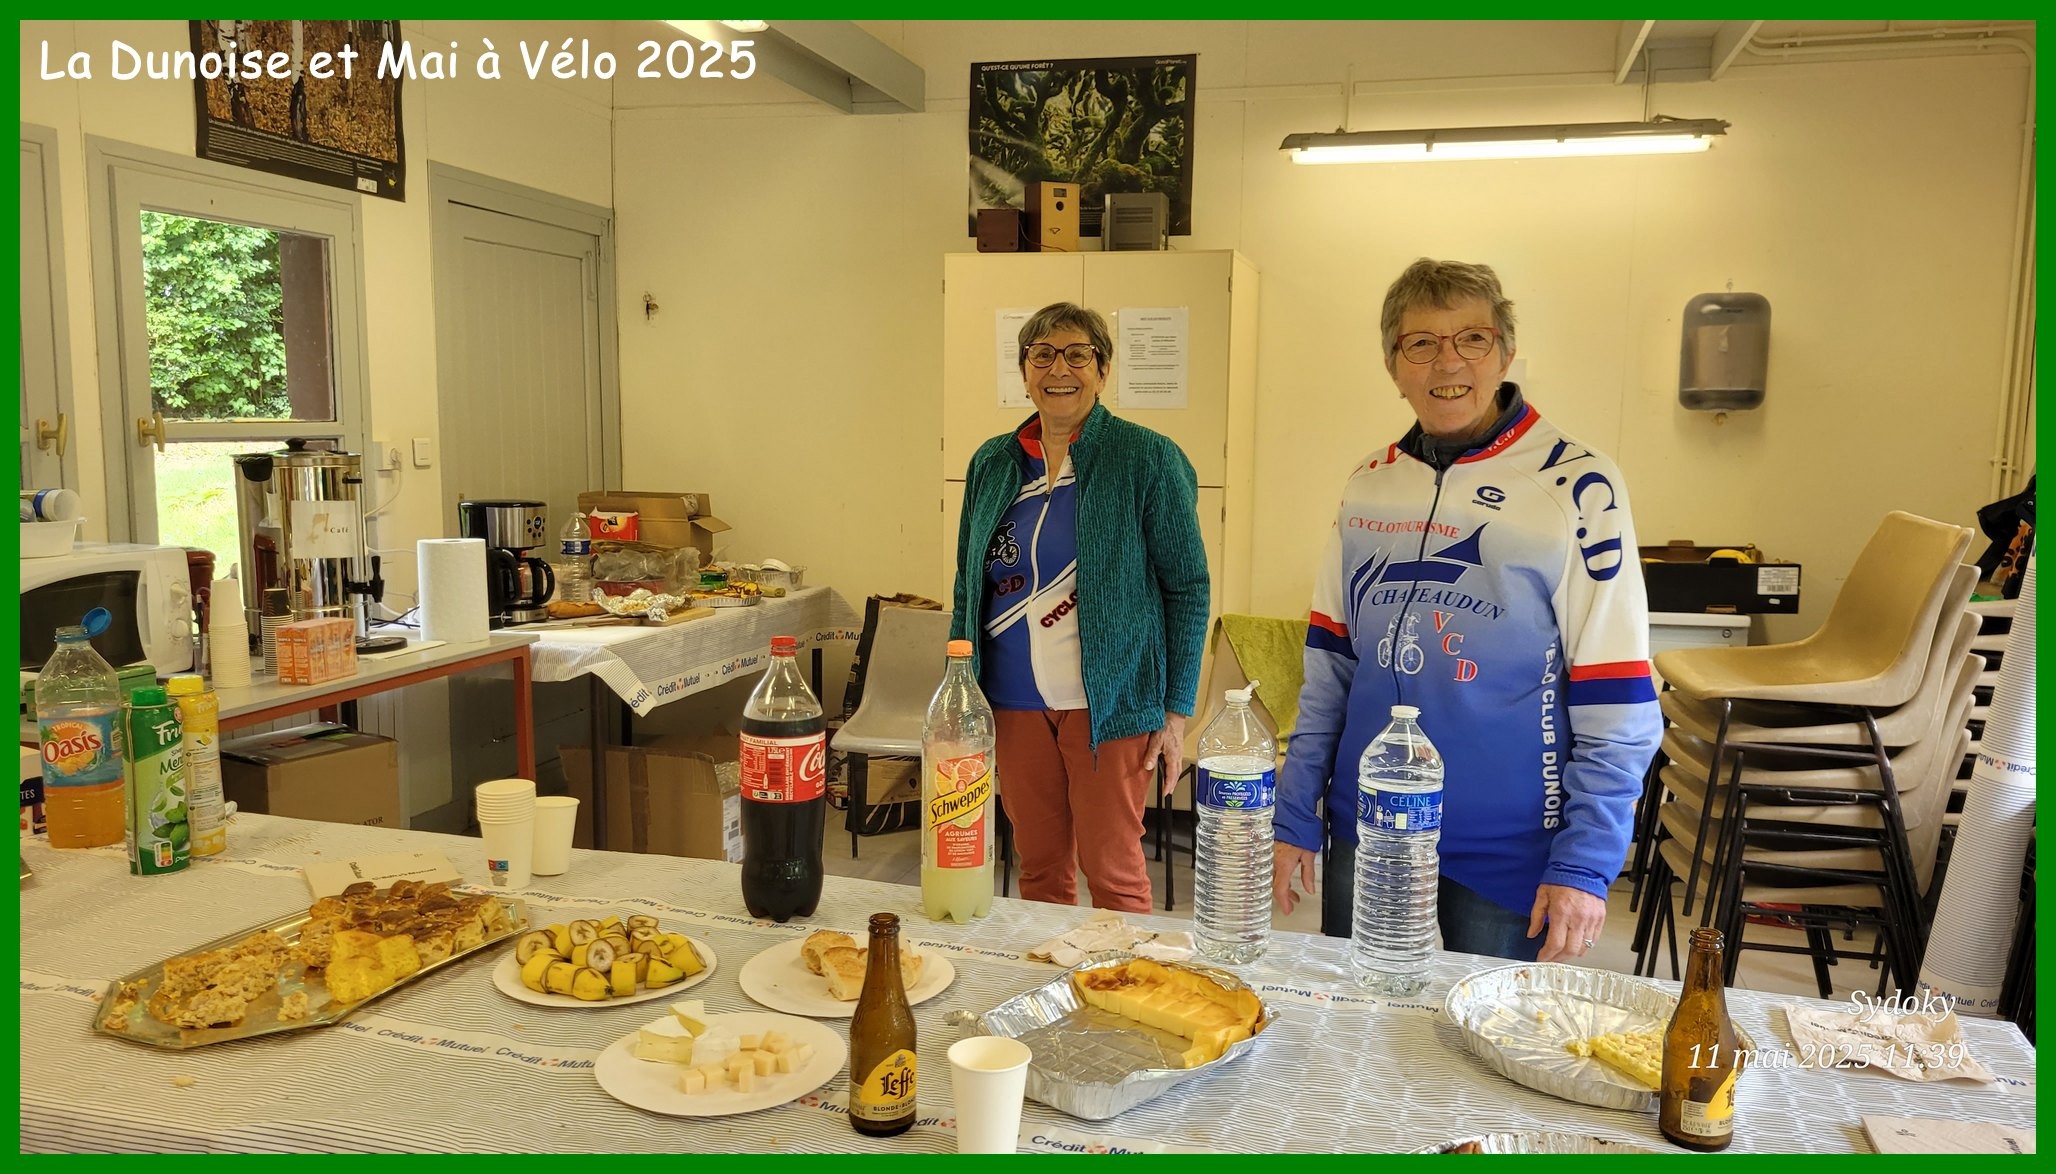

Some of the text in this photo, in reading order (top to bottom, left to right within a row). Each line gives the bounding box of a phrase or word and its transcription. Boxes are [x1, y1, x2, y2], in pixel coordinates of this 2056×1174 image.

[1031, 61, 1050, 69] FORÊT
[1371, 587, 1506, 621] CHATEAUDUN
[631, 688, 650, 709] édit
[1540, 689, 1557, 746] CLUB
[43, 730, 103, 765] Oasis
[1541, 750, 1563, 831] DUNOIS
[931, 779, 991, 825] Schweppes
[945, 829, 979, 838] AGRUMES
[712, 914, 755, 927] Mutuel
[918, 940, 964, 953] Mutuel
[1261, 984, 1312, 998] Mutuel
[1387, 1001, 1440, 1014] Mutuel
[377, 1028, 423, 1044] Crédit
[436, 1038, 490, 1054] Mutuel
[495, 1046, 544, 1066] Crédit
[558, 1059, 595, 1070] Mutu
[1031, 1134, 1087, 1154] Crédit
